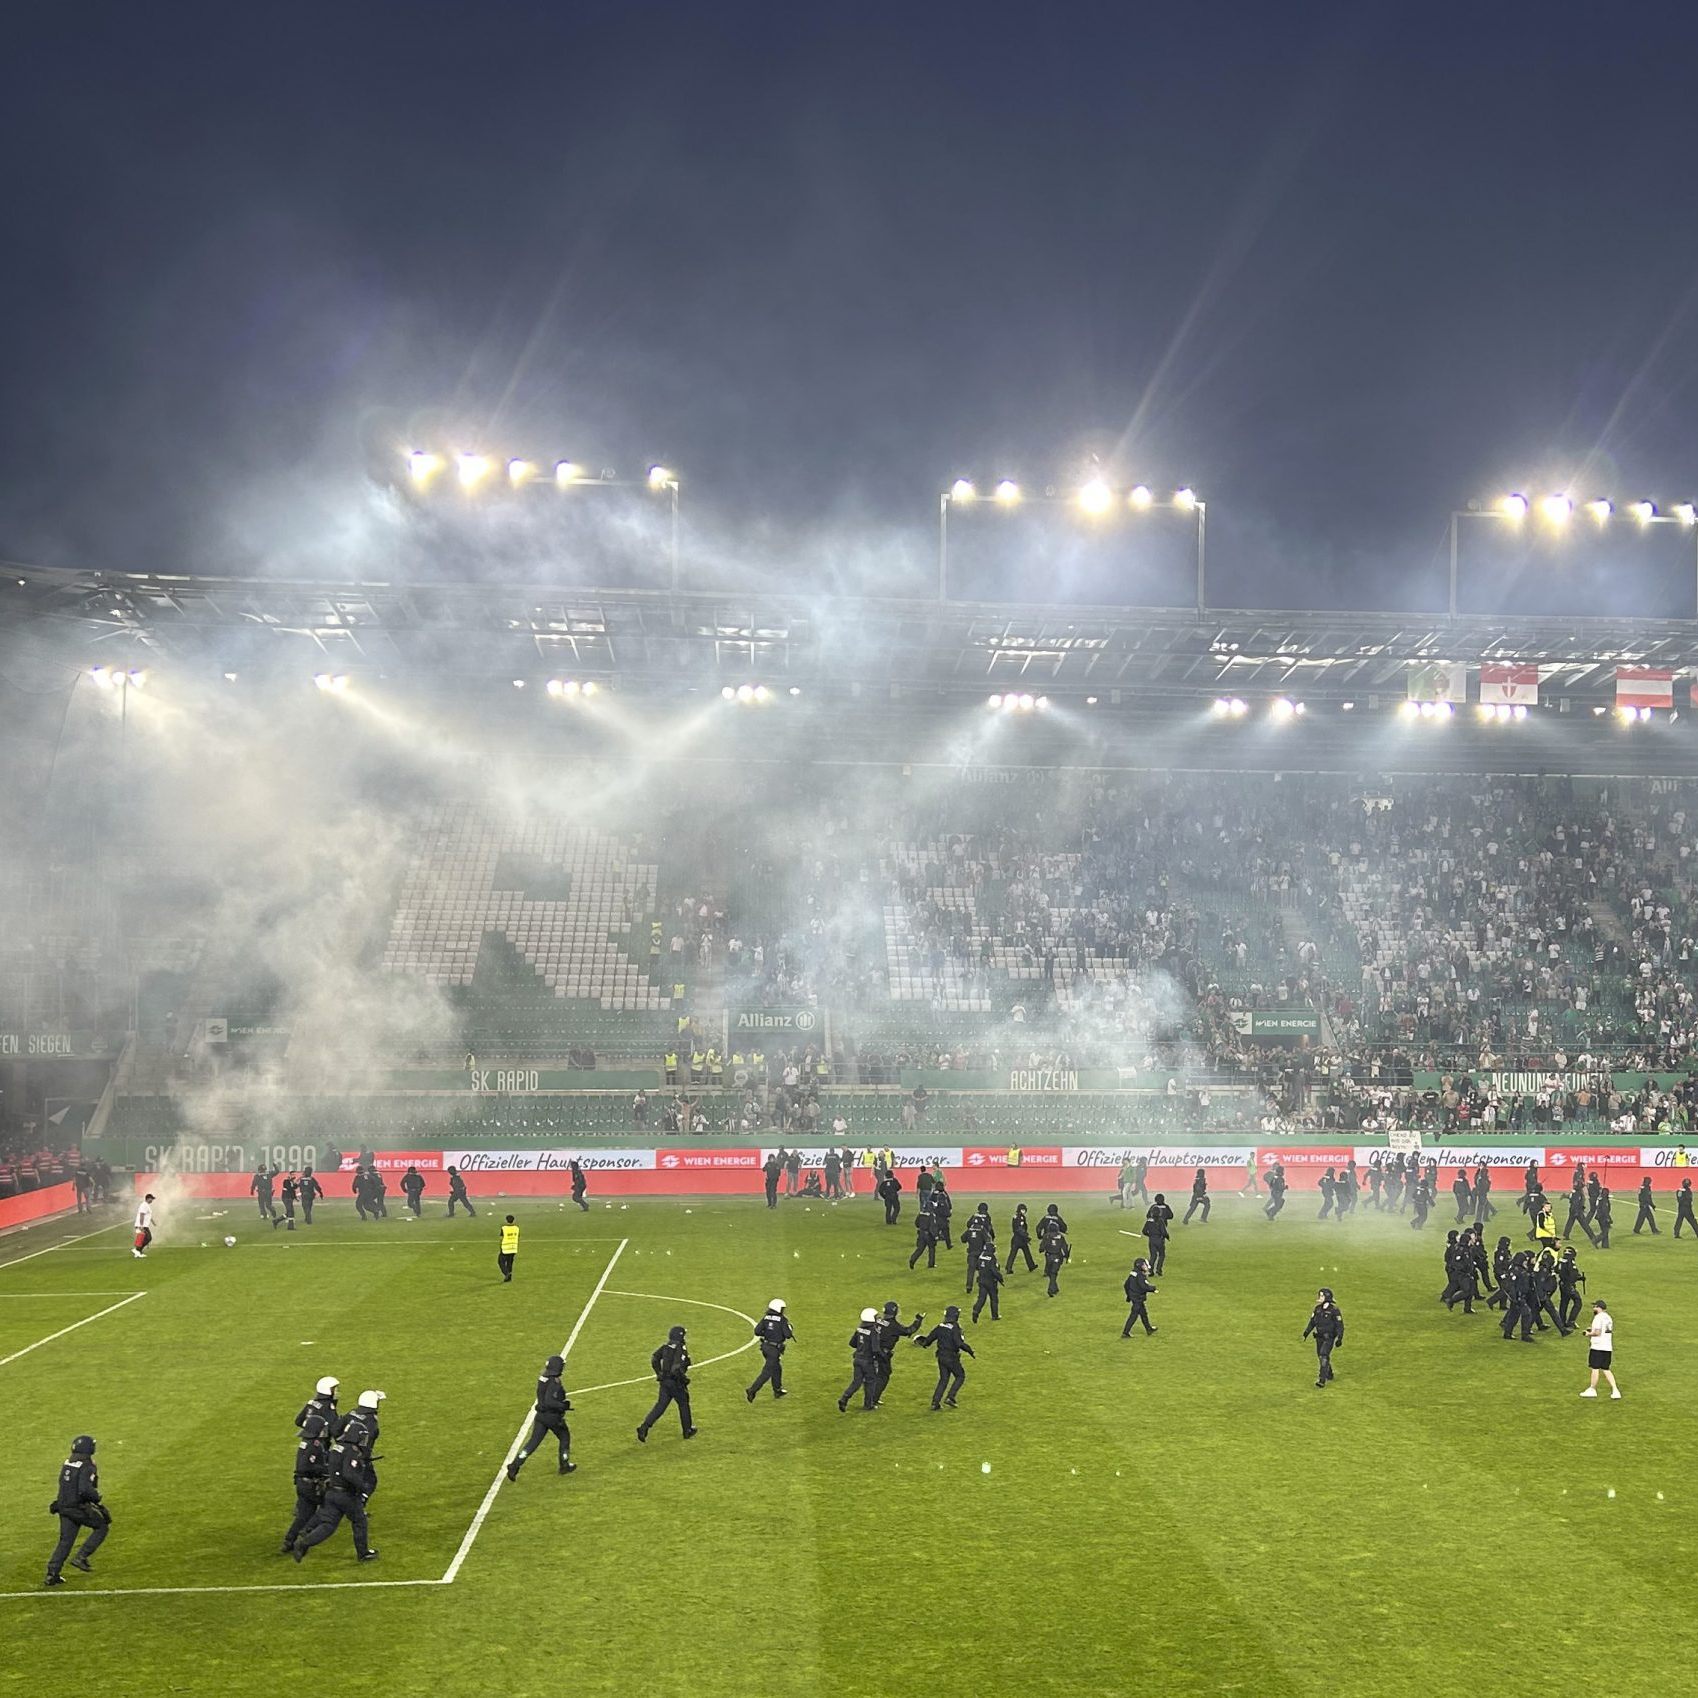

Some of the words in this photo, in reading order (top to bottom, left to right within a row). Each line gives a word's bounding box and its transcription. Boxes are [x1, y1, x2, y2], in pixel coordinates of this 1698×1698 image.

[738, 1013, 794, 1028] Allianz
[1255, 1020, 1279, 1028] WIEN
[1281, 1020, 1317, 1028] ENERGIE
[471, 1071, 490, 1091] SK
[497, 1071, 539, 1091] RAPID
[1010, 1071, 1079, 1091] ACHTZEHN
[262, 1145, 317, 1173] 1899
[393, 1159, 438, 1169] ENERGIE
[460, 1153, 532, 1171] Offizieller
[683, 1156, 712, 1166] WIEN
[714, 1156, 757, 1166] ENERGIE
[1022, 1155, 1058, 1164] NERGIE
[1148, 1149, 1246, 1168] Hauptsponsor.
[1282, 1154, 1309, 1163] WIEN
[1310, 1154, 1350, 1163] ENERGIE
[1570, 1155, 1597, 1164] WIEN
[1598, 1155, 1637, 1164] ENERGIE
